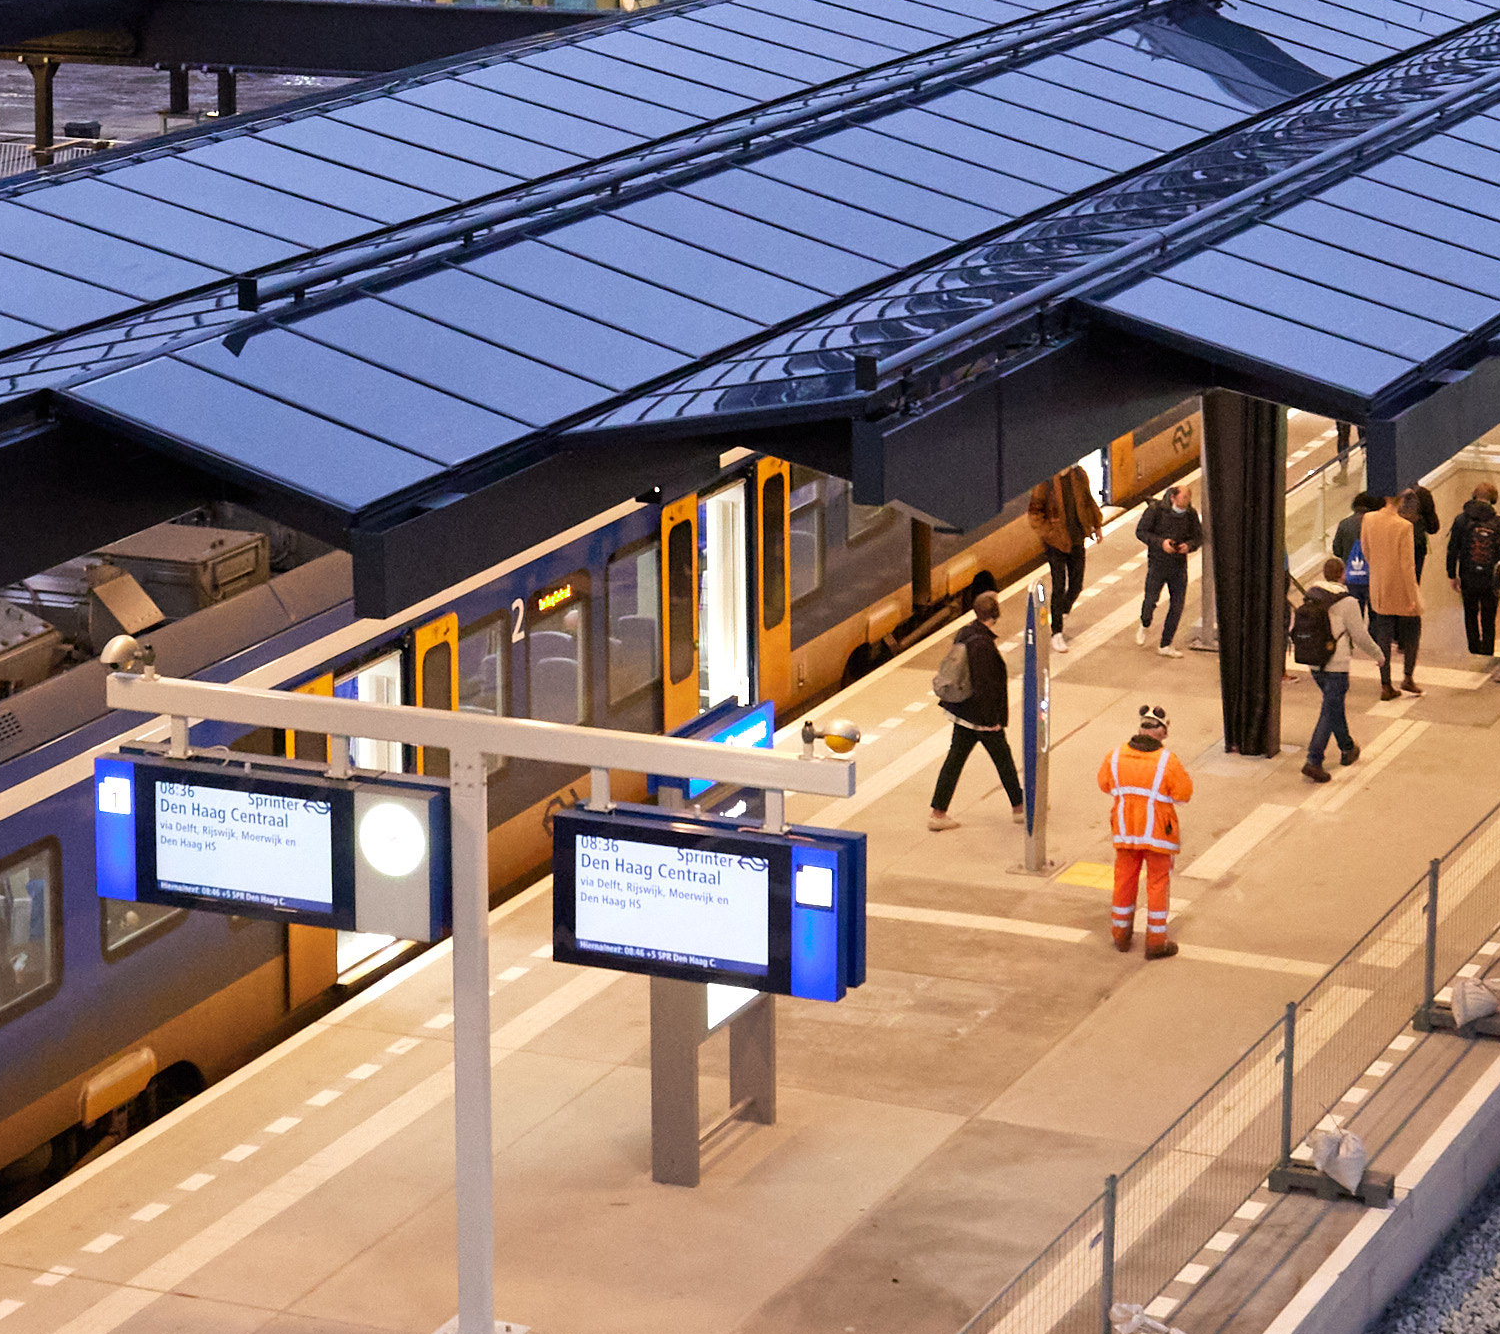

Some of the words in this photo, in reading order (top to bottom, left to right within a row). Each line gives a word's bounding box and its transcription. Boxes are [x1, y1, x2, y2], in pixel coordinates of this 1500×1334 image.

[511, 598, 525, 644] 2
[112, 792, 117, 808] 1
[160, 782, 195, 798] 08:36
[248, 793, 300, 811] Sprinter
[160, 798, 187, 816] Den
[191, 802, 226, 824] Haag
[230, 807, 289, 829] Centraal
[160, 821, 173, 831] via
[176, 822, 199, 835] Delft,
[202, 825, 239, 841] Rijswijk,
[241, 830, 282, 847] Moerwijk
[285, 838, 296, 847] en
[160, 835, 178, 847] Den
[180, 839, 203, 852] Haag
[205, 840, 217, 851] HS
[581, 835, 619, 853] 08:36
[677, 848, 734, 868] Sprinter
[581, 853, 610, 871] Den
[614, 858, 653, 881] Haag
[658, 863, 722, 886] Centraal
[232, 890, 245, 901] SPR
[246, 893, 260, 903] Den
[261, 895, 279, 907] Haag
[580, 876, 595, 888] via
[597, 878, 623, 893] Delft,
[626, 882, 666, 899] Rijswijk,
[669, 888, 714, 906] Moerwijk
[716, 896, 730, 906] en
[580, 892, 600, 904] Den
[602, 896, 627, 910] Haag
[629, 899, 642, 910] HS
[657, 952, 672, 962] SPR
[673, 953, 688, 963] Den
[689, 955, 708, 968] Haag
